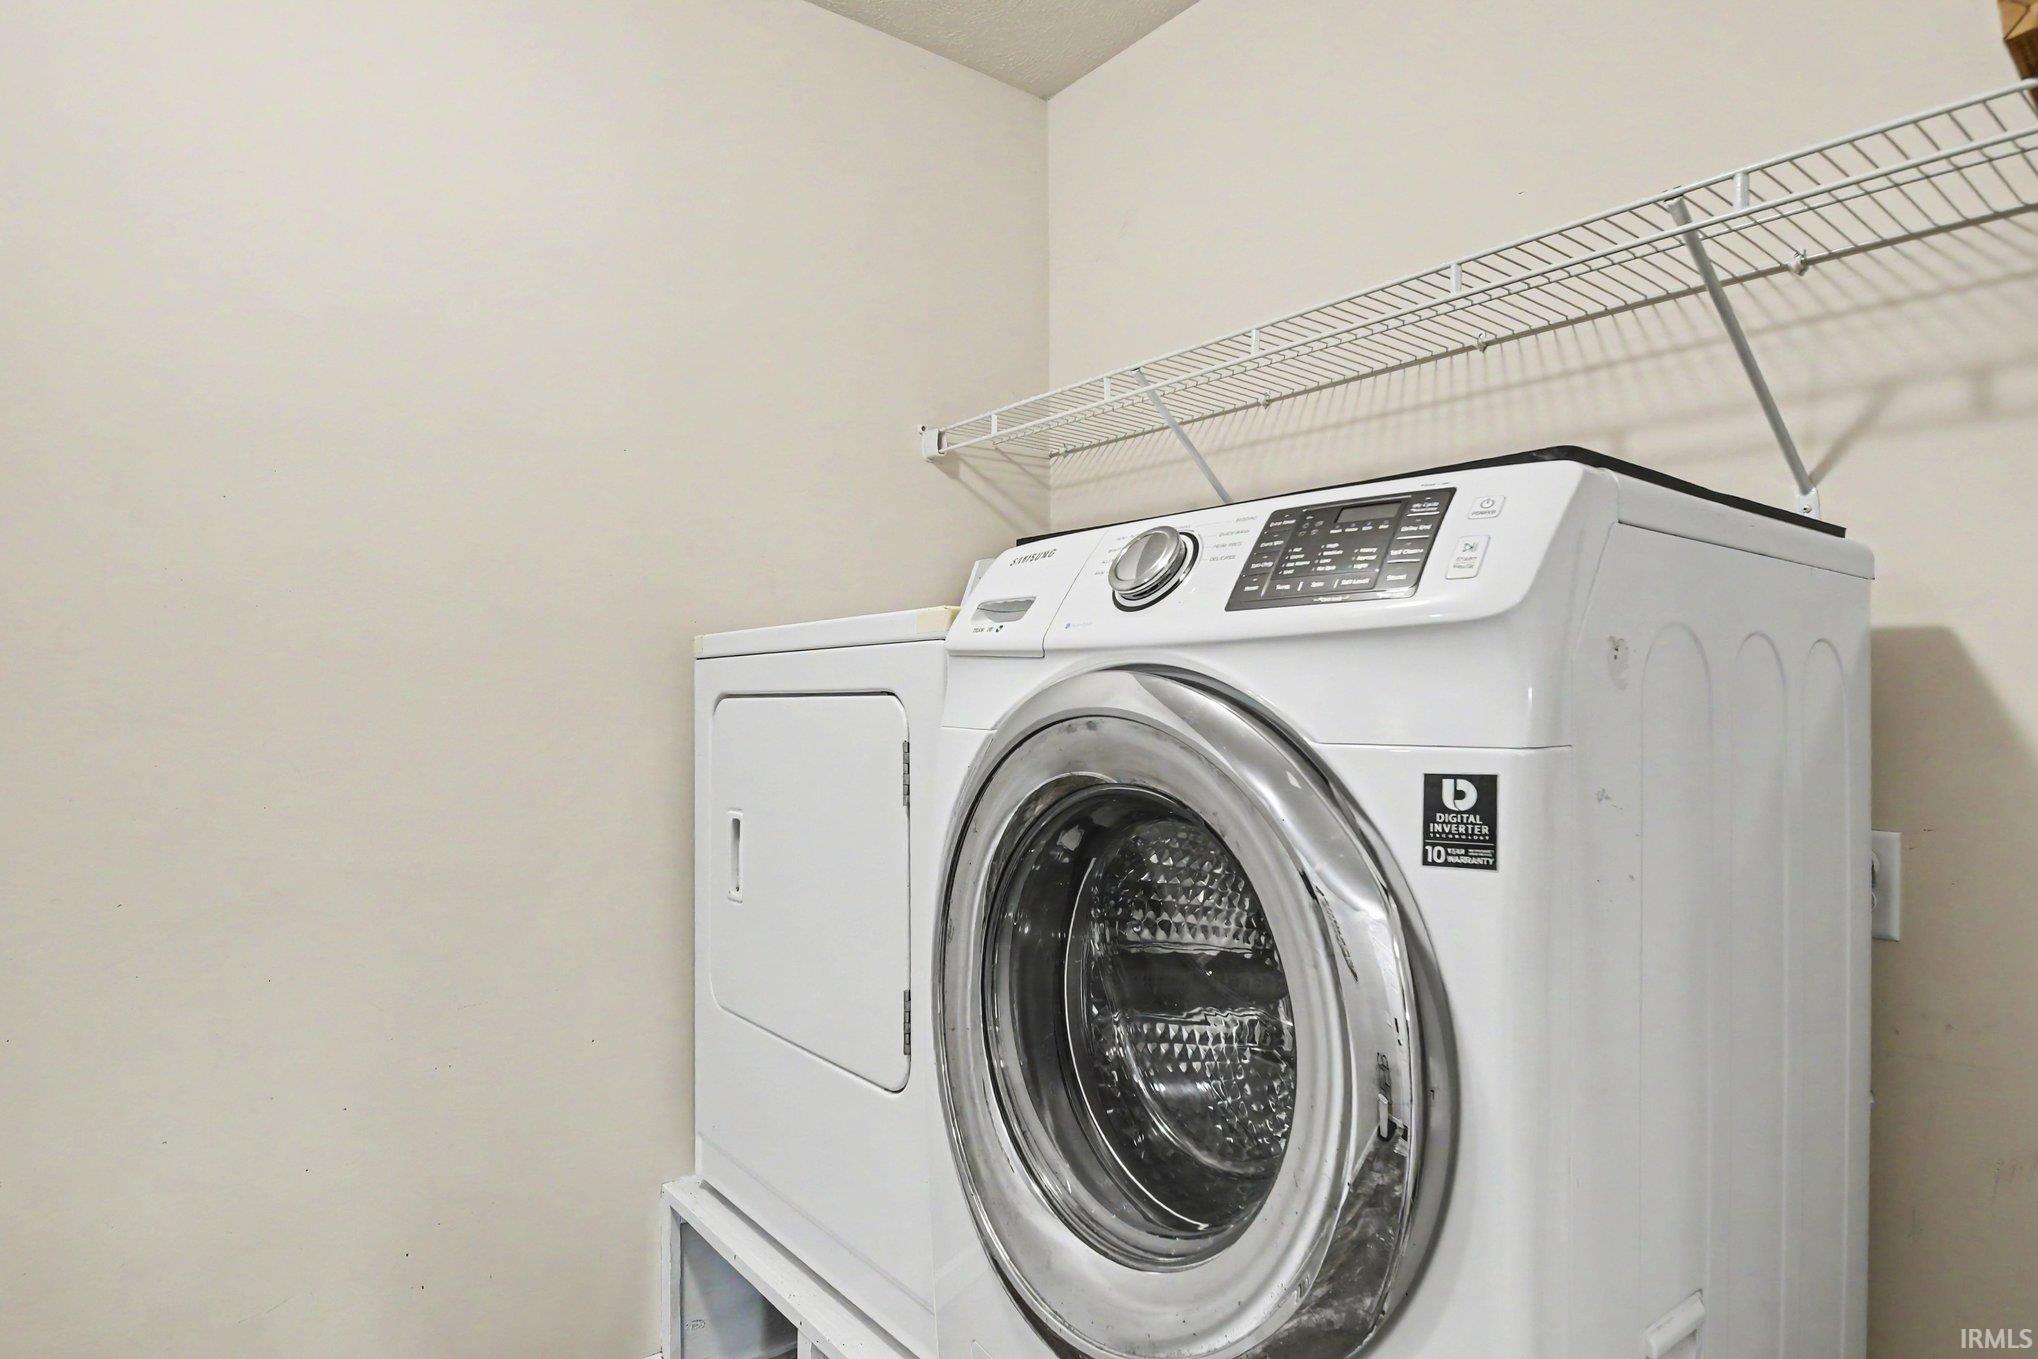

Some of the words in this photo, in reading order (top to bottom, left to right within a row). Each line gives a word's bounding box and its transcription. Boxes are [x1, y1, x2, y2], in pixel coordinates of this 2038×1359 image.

[1008, 548, 1058, 567] SAMSUNG
[1435, 812, 1483, 824] DIGITAL
[1429, 823, 1490, 835] INVERTER
[1425, 845, 1446, 864] 10
[1446, 855, 1495, 866] WARRANTY
